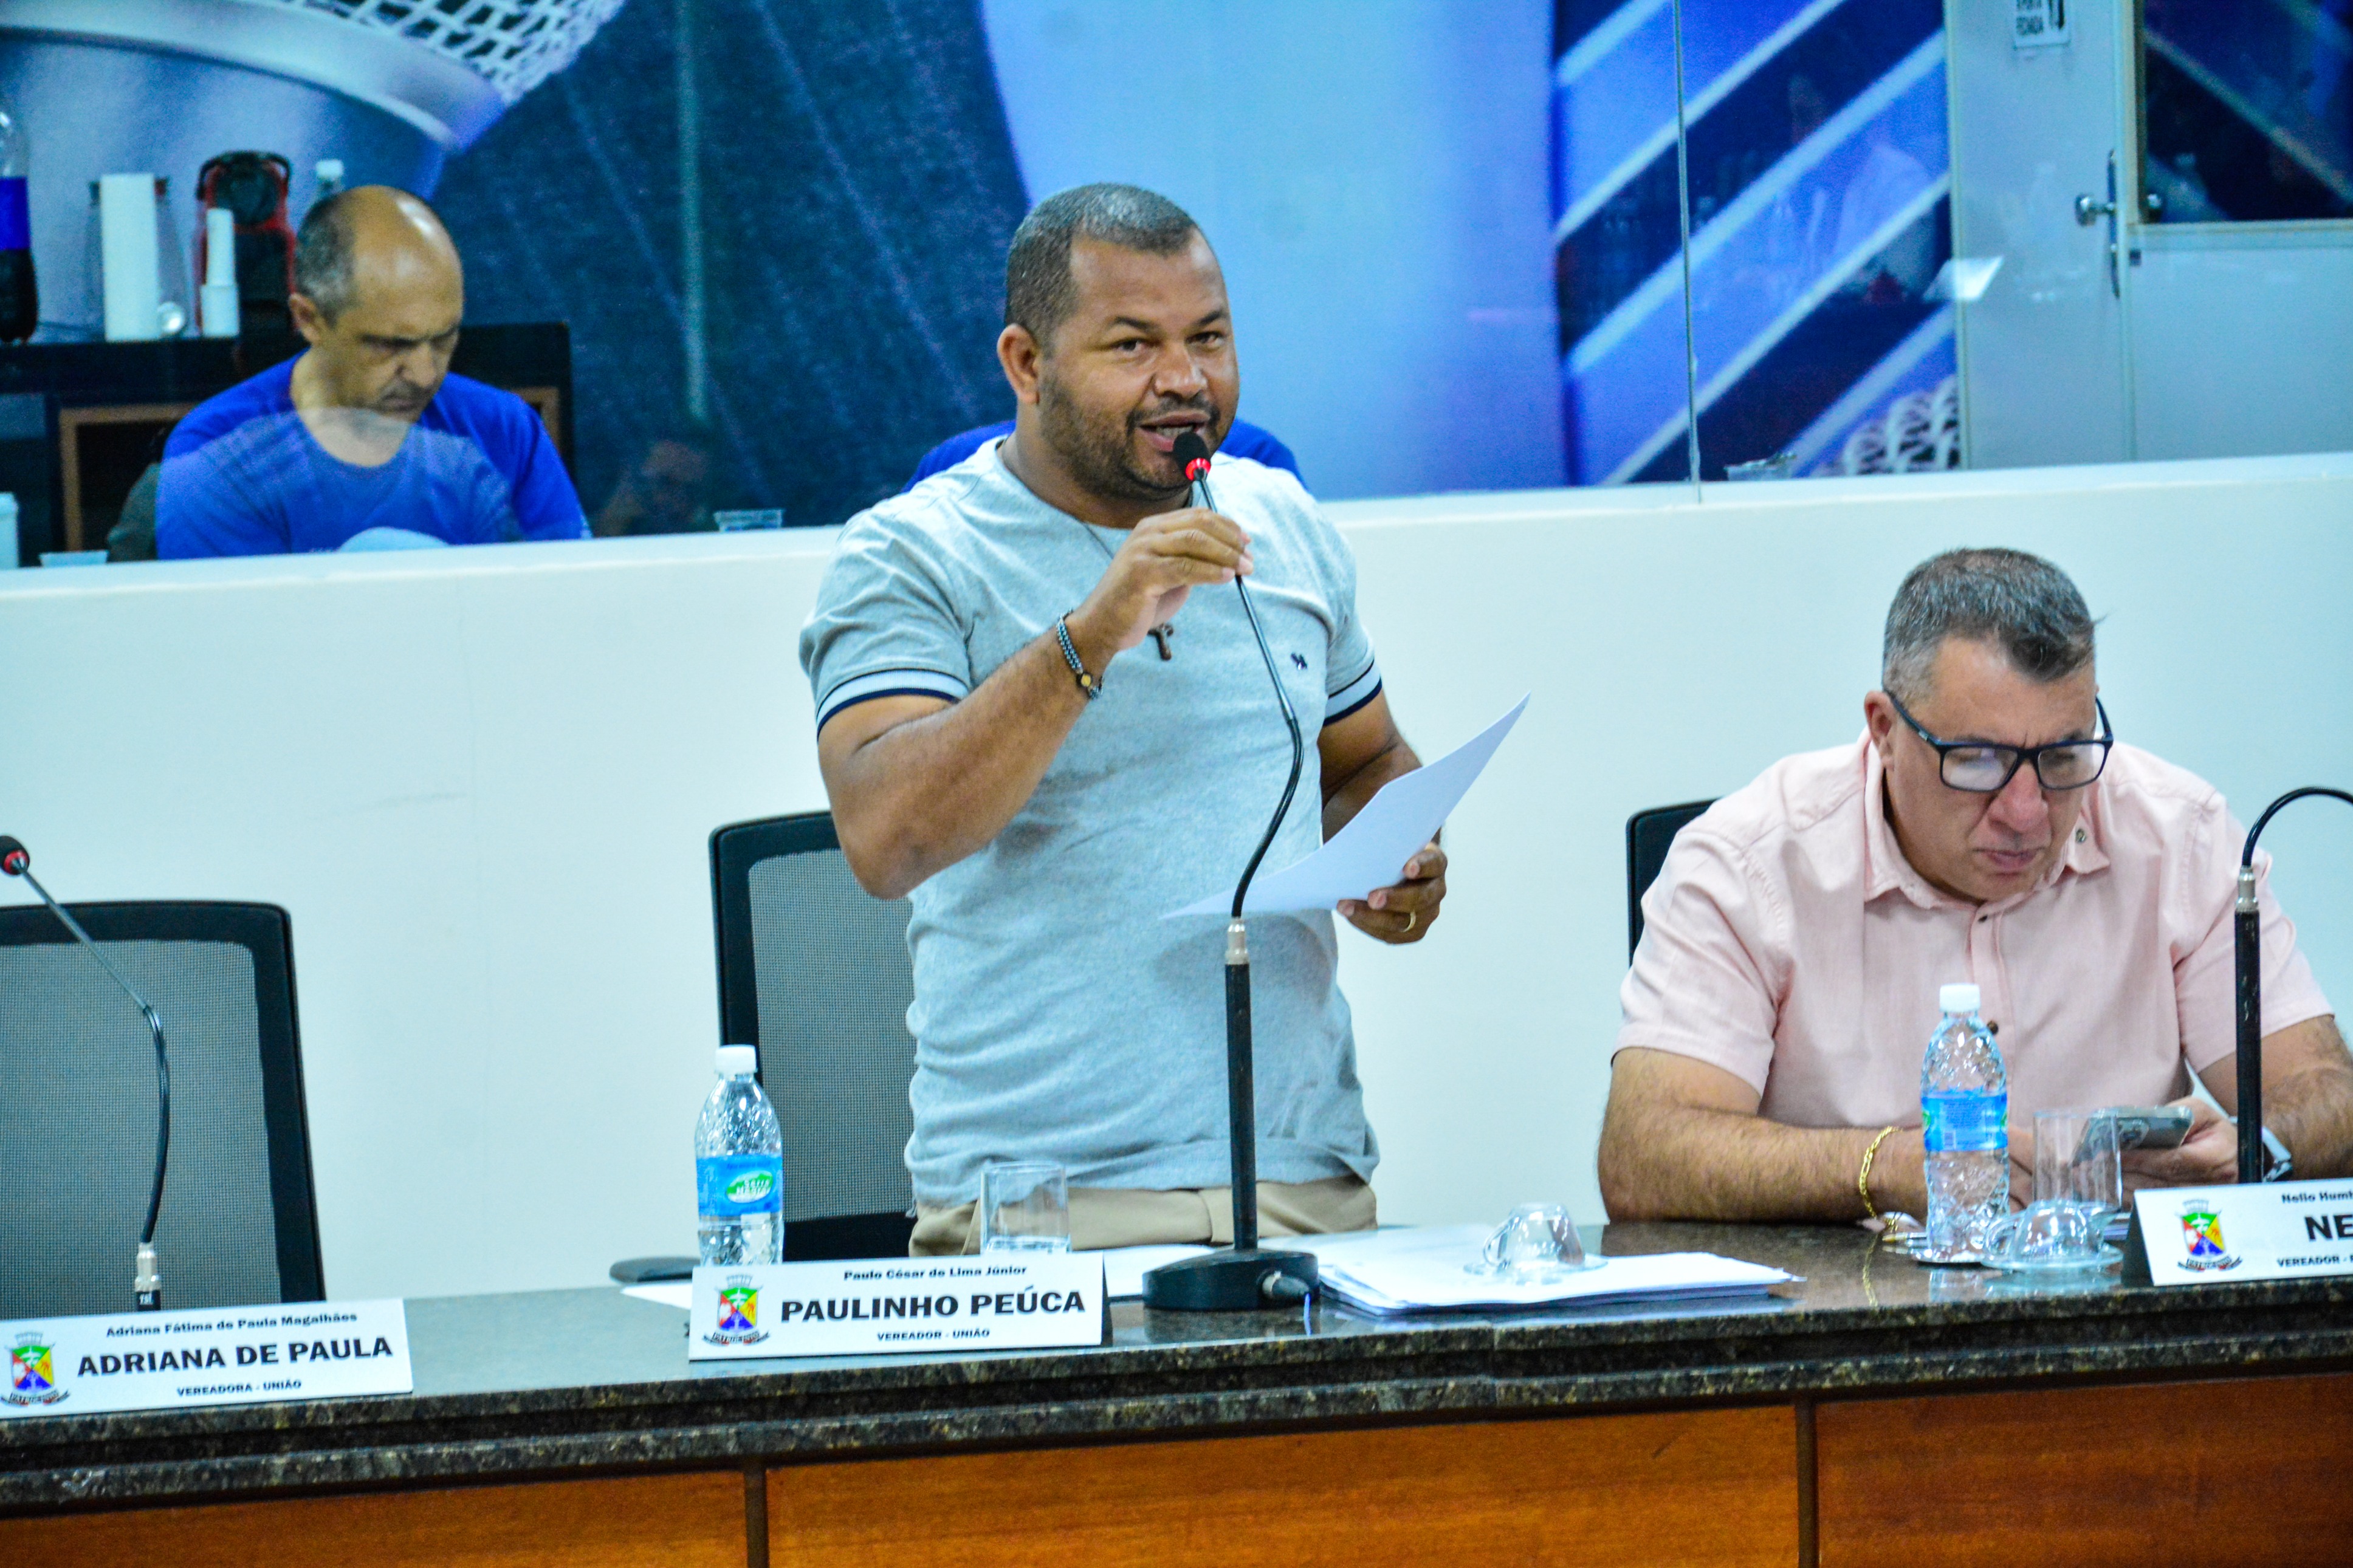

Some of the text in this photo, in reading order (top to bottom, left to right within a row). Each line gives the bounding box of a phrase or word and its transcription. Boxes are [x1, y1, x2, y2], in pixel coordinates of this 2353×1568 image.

[2304, 1213, 2353, 1241] NE
[2277, 1255, 2340, 1267] VEREADOR
[843, 1266, 1026, 1280] Paulo César de Lima Júnior
[781, 1285, 1085, 1323] PAULINHO PEÚCA
[106, 1313, 357, 1337] Adriana Fátima de Paula Magalhães
[877, 1331, 942, 1341] VEREADOR
[952, 1328, 990, 1338] UNIÃO
[77, 1337, 393, 1377] ADRIANA DE PAULA
[177, 1383, 252, 1397] VEREADORA
[263, 1379, 302, 1391] UNIÃO
